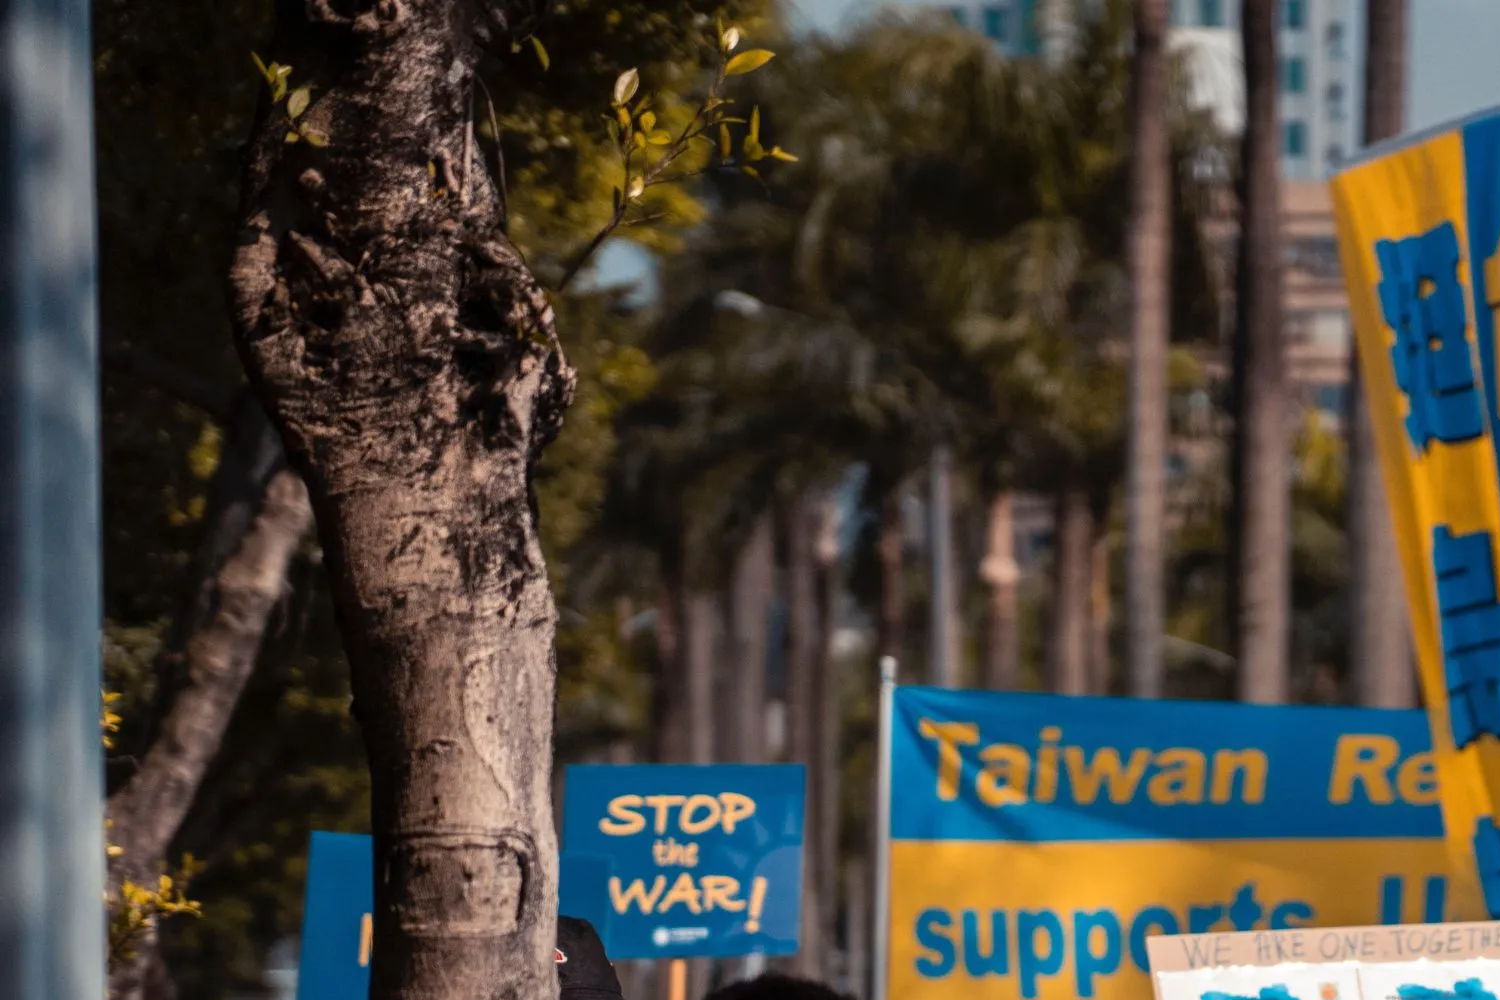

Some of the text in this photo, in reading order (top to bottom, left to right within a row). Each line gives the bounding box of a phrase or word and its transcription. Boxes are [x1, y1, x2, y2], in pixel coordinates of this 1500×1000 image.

[919, 717, 1268, 806] Taiwan
[598, 791, 756, 835] STOP
[653, 838, 700, 868] the
[608, 872, 768, 933] WAR!
[1181, 934, 1231, 968] WE
[1253, 931, 1305, 963] ARE
